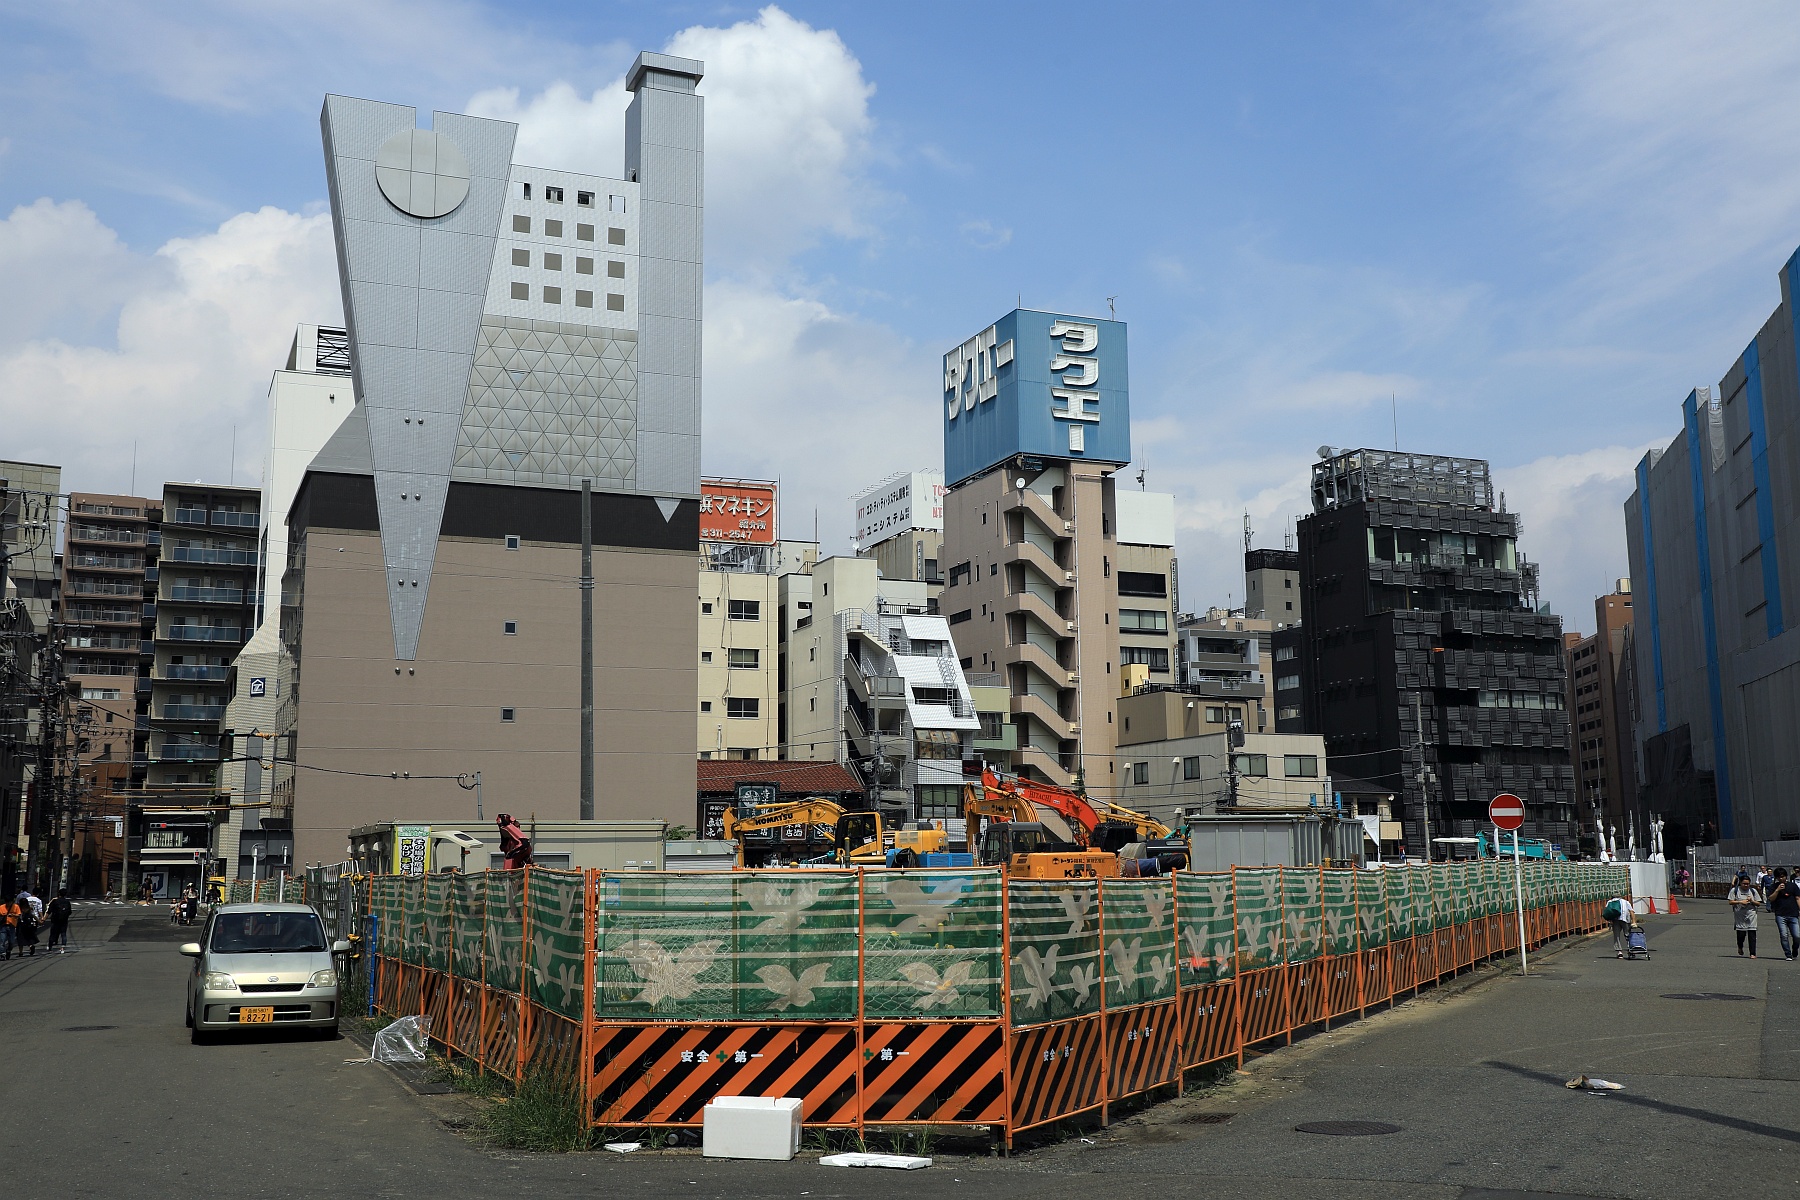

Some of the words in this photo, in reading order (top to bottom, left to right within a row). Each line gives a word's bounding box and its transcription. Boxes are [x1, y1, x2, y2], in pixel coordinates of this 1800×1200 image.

[1029, 790, 1052, 803] HITACHI
[755, 811, 794, 826] KOMATSU
[246, 1013, 271, 1023] 82-21
[680, 1049, 709, 1063] 安全
[734, 1049, 764, 1063] 第一
[880, 1047, 910, 1061] 第一
